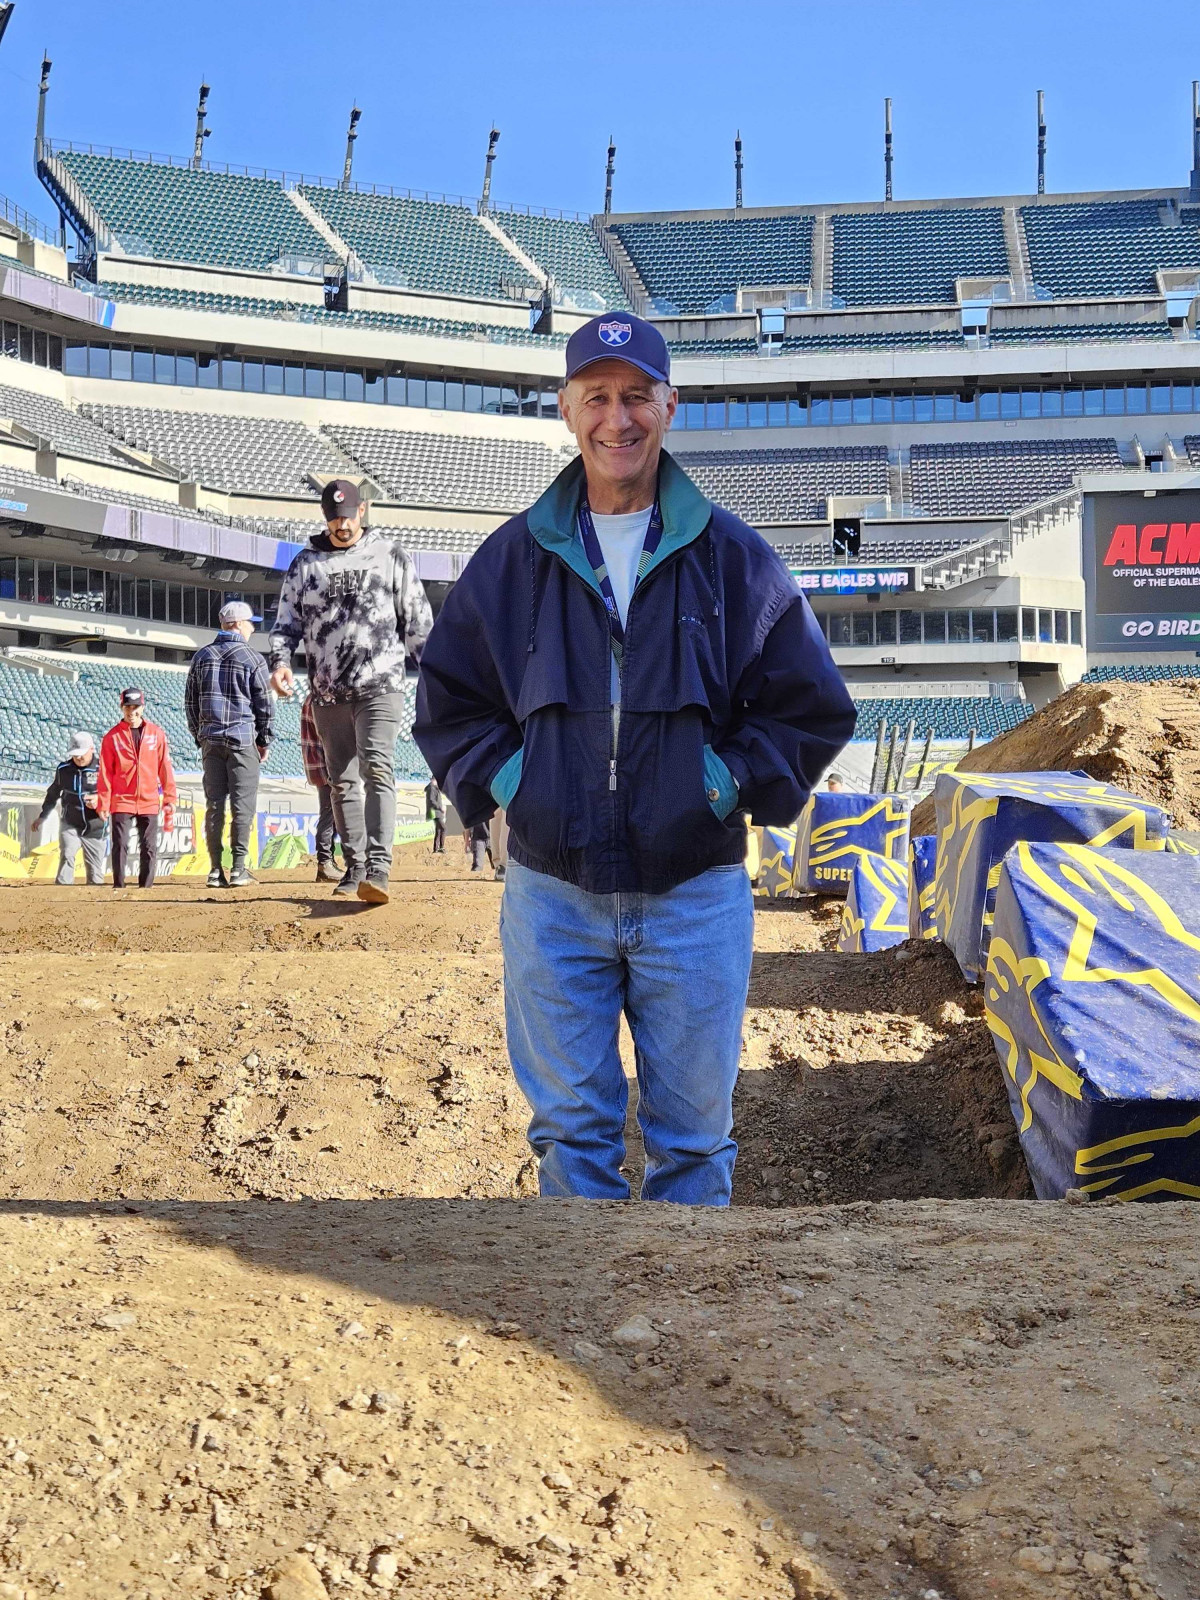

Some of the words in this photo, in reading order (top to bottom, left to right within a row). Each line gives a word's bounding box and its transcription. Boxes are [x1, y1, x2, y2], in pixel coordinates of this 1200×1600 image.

[606, 330, 622, 343] X
[1112, 568, 1154, 577] OFFICIAL
[329, 569, 369, 598] FLY
[821, 573, 876, 588] EAGLES
[877, 572, 909, 587] WIFI
[1133, 579, 1147, 587] OF
[1148, 579, 1167, 587] THE
[1122, 620, 1154, 636] GO
